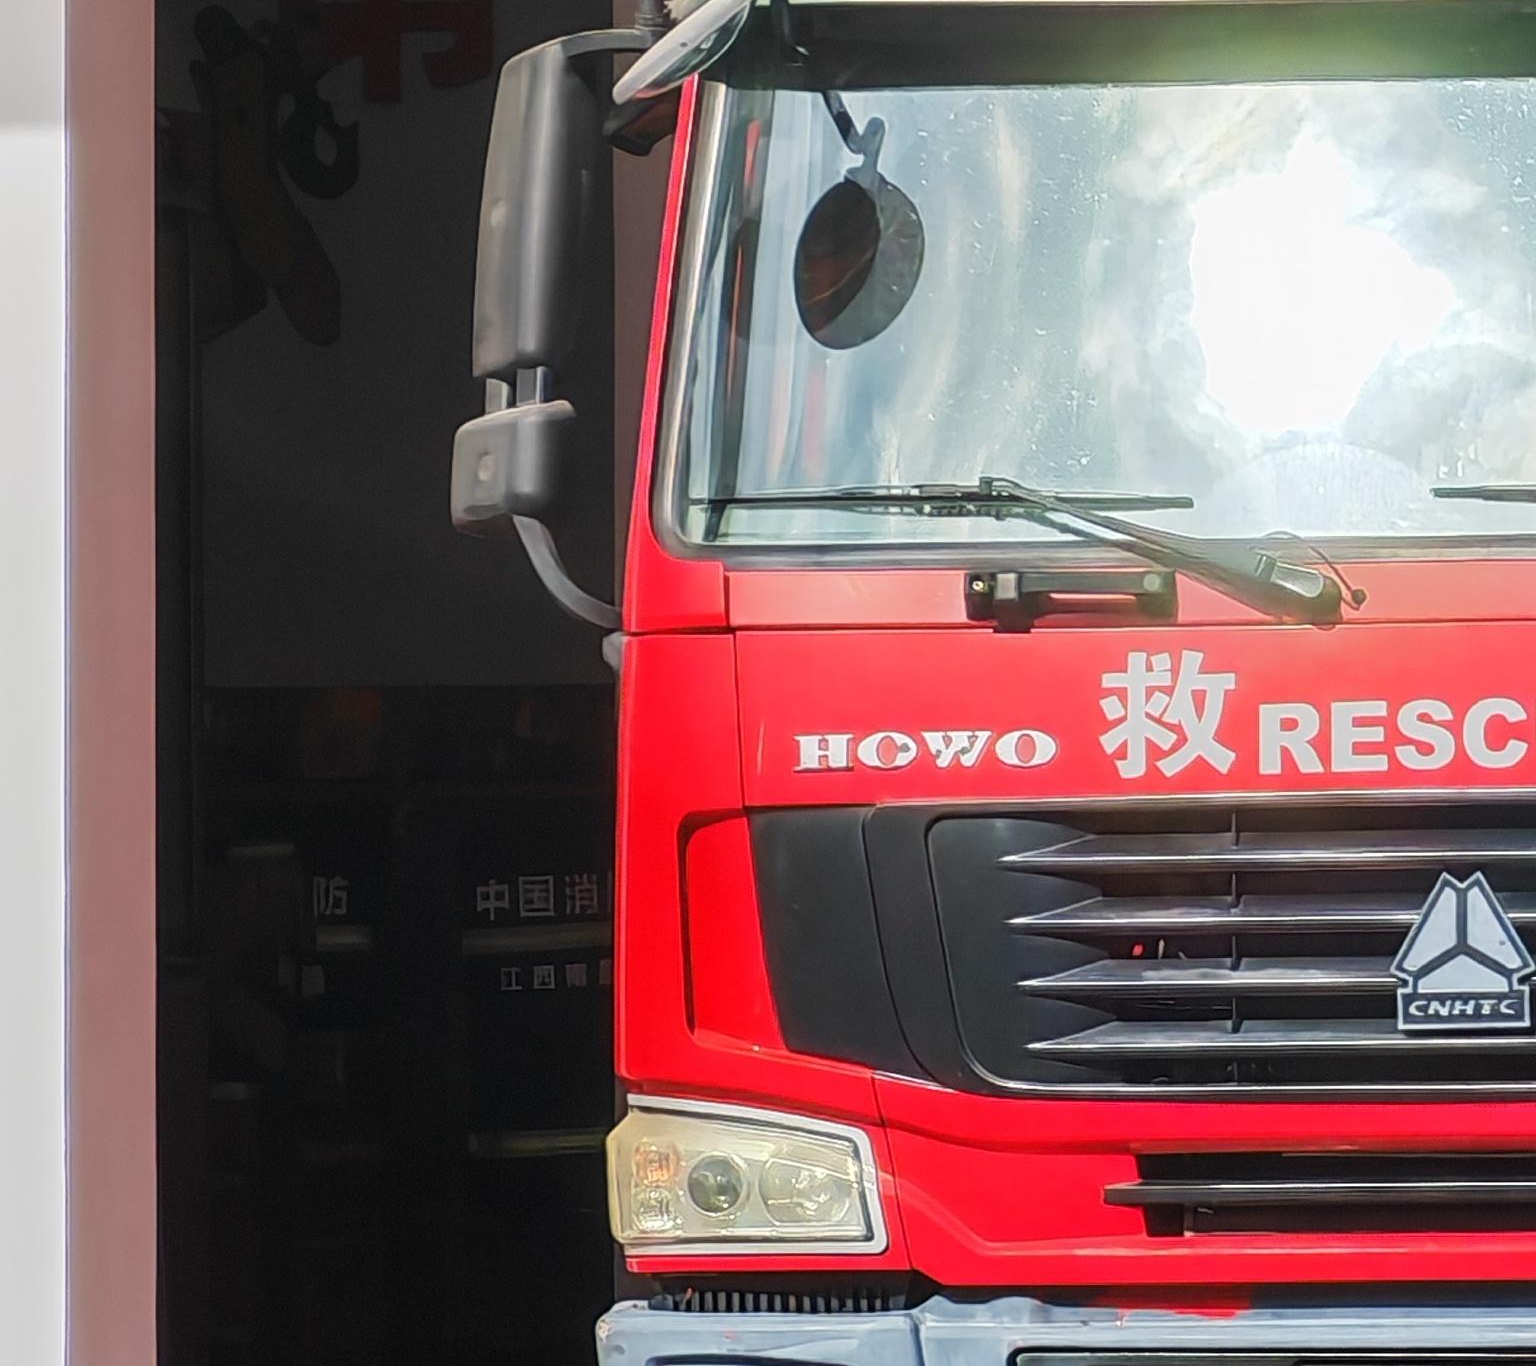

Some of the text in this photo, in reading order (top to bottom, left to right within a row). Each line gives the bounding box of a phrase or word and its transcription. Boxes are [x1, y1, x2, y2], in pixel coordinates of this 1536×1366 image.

[1099, 650, 1238, 779] 救
[793, 729, 1058, 772] HOWO
[475, 872, 612, 921] 中国消
[1408, 999, 1520, 1016] CNHTC
